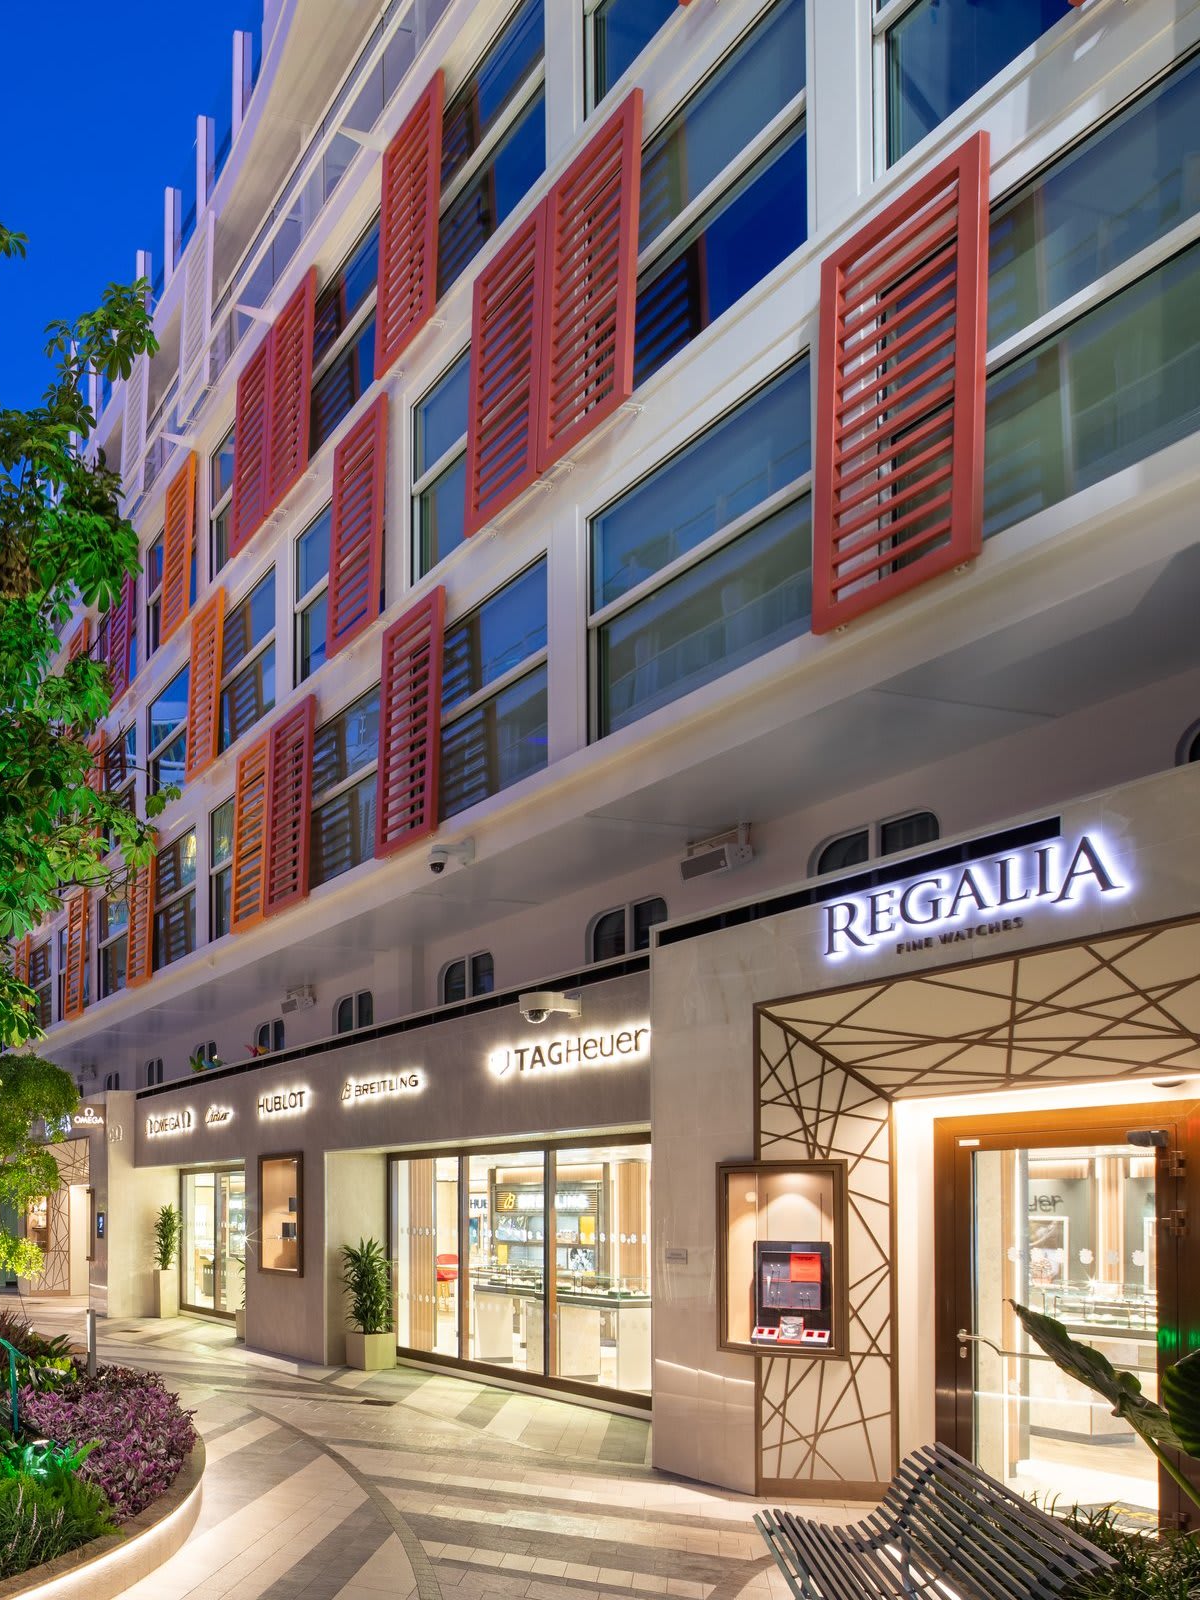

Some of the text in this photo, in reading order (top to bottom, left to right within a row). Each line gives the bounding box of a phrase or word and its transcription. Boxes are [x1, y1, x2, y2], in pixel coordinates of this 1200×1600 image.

[823, 836, 1125, 956] REGALIA
[896, 916, 1025, 954] FINE WATCHES
[354, 1074, 419, 1097] BREITLING
[257, 1091, 305, 1115] HUBLOT
[73, 1115, 105, 1125] OMEGA
